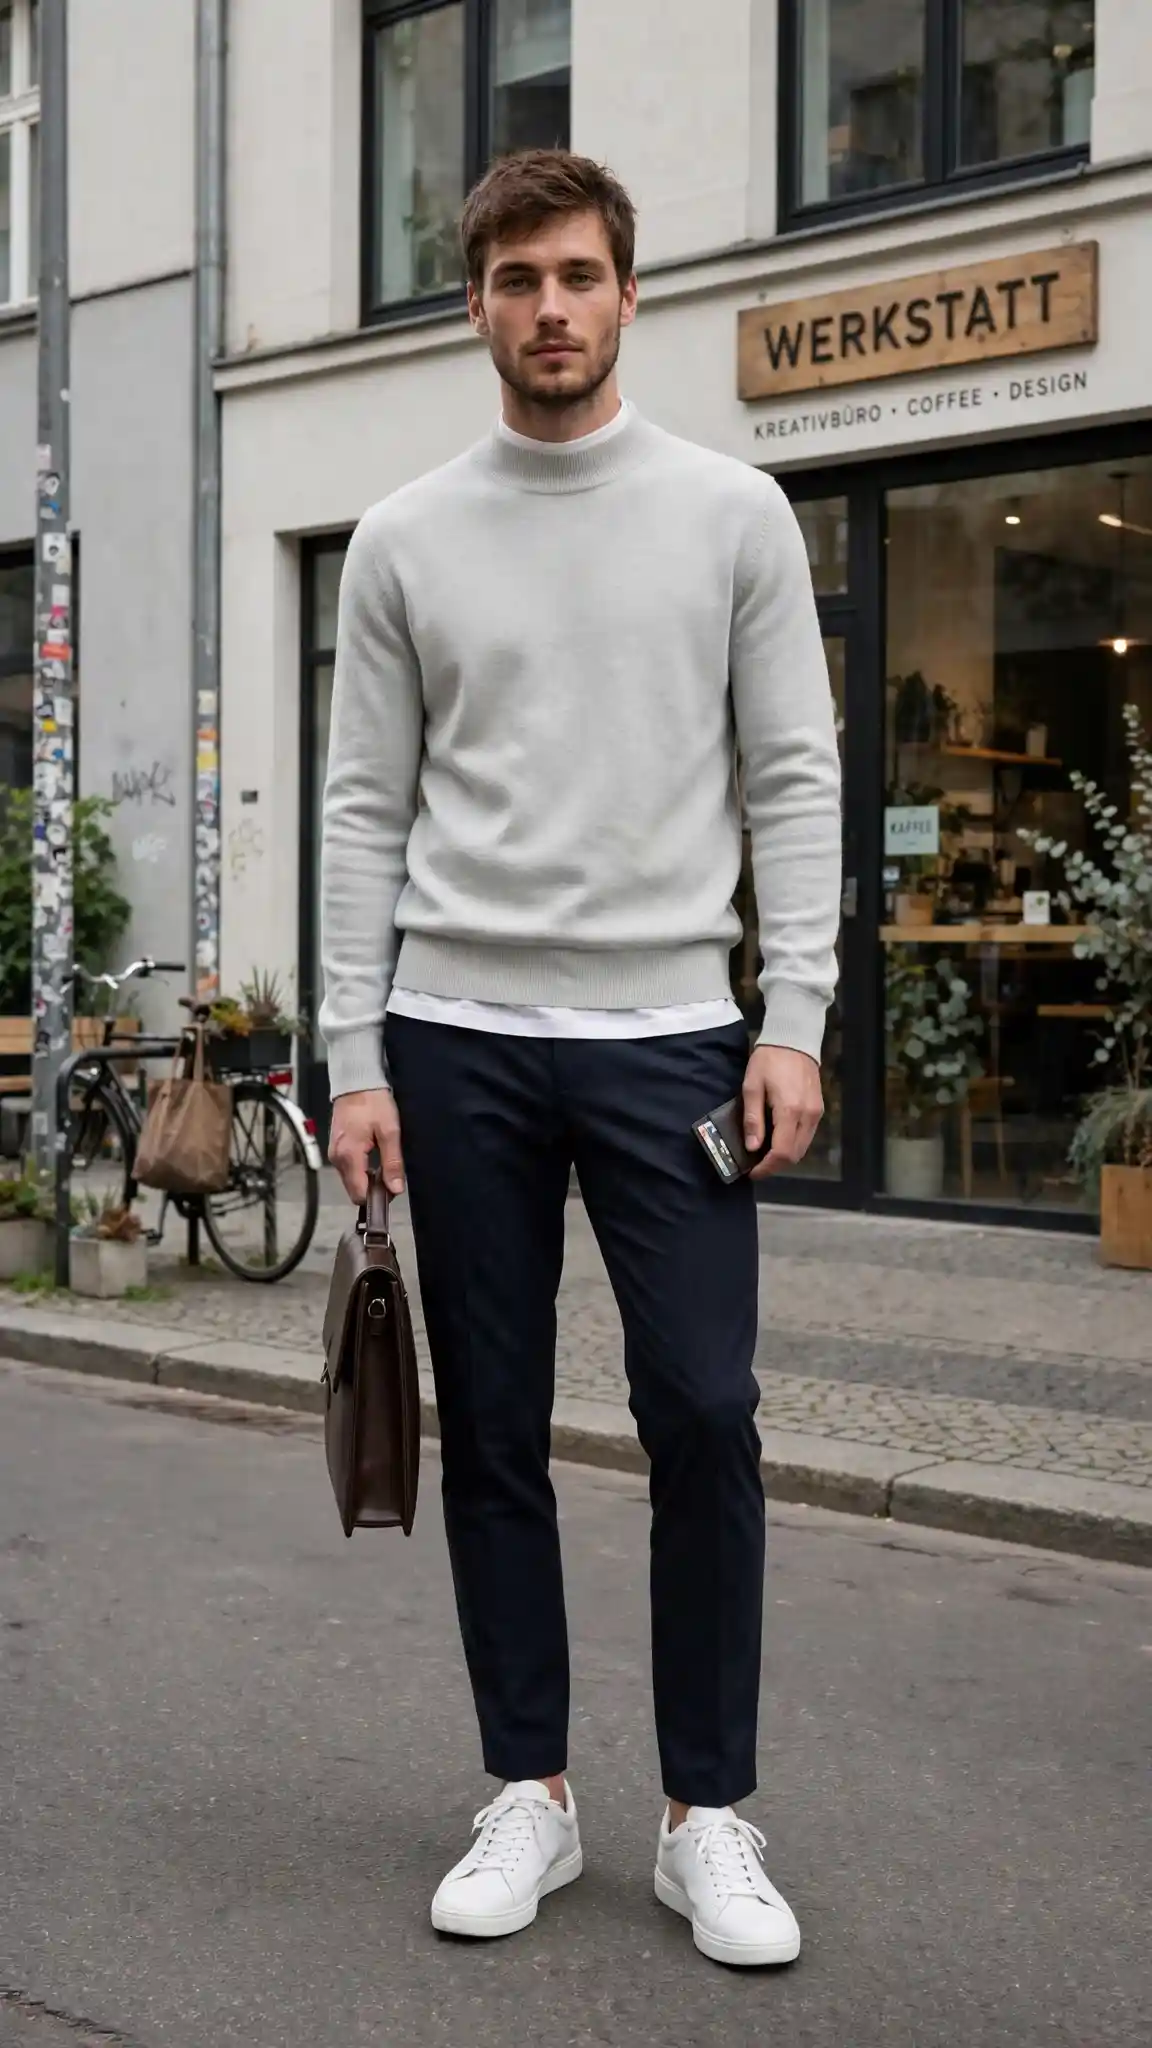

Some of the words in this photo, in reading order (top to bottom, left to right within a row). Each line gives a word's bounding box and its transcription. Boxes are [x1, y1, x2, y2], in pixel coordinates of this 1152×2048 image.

[764, 272, 1060, 371] WERKSTATT
[907, 388, 982, 416] COFFEE
[1009, 371, 1088, 401] DESIGN
